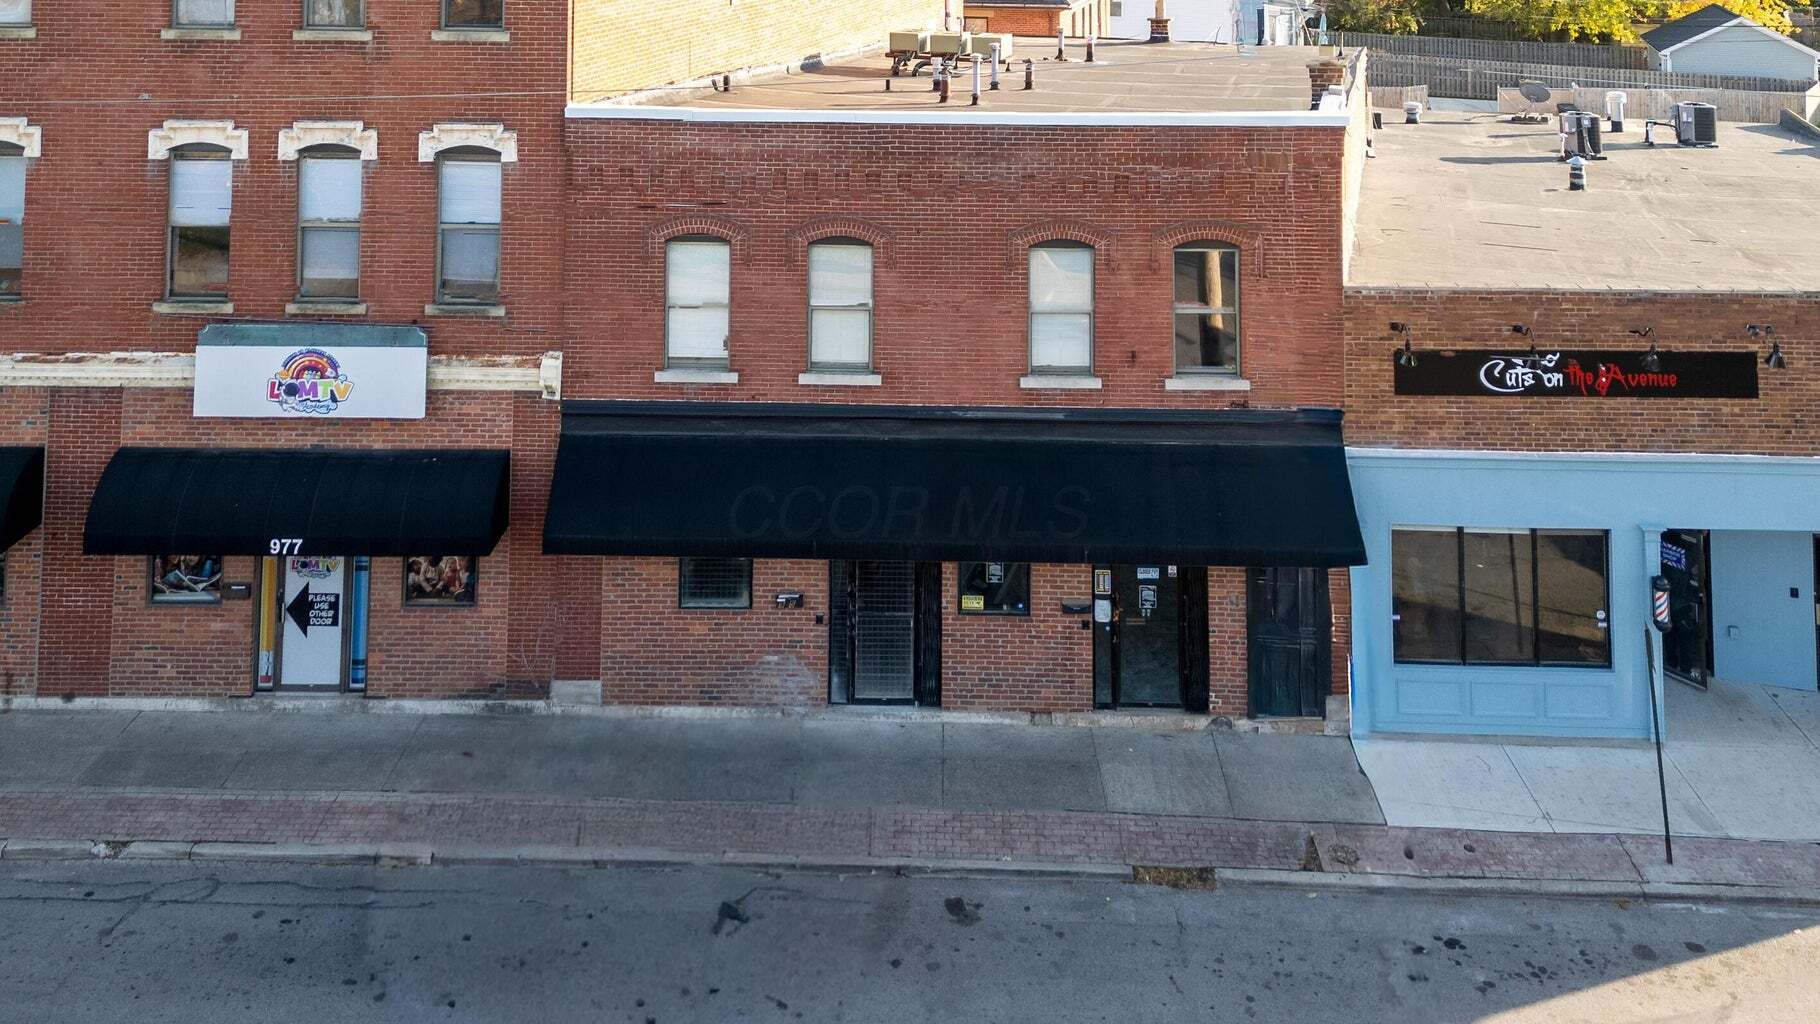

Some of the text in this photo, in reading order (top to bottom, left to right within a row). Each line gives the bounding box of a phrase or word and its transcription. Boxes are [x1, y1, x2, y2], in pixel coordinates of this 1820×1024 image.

[1479, 358, 1536, 393] Cuts
[1544, 372, 1564, 388] on
[1596, 364, 1678, 396] Avenue
[270, 538, 303, 555] 977
[308, 594, 336, 602] PLEASE
[314, 602, 330, 610] USE
[309, 610, 334, 618] OTHER
[310, 617, 333, 626] DOOR
